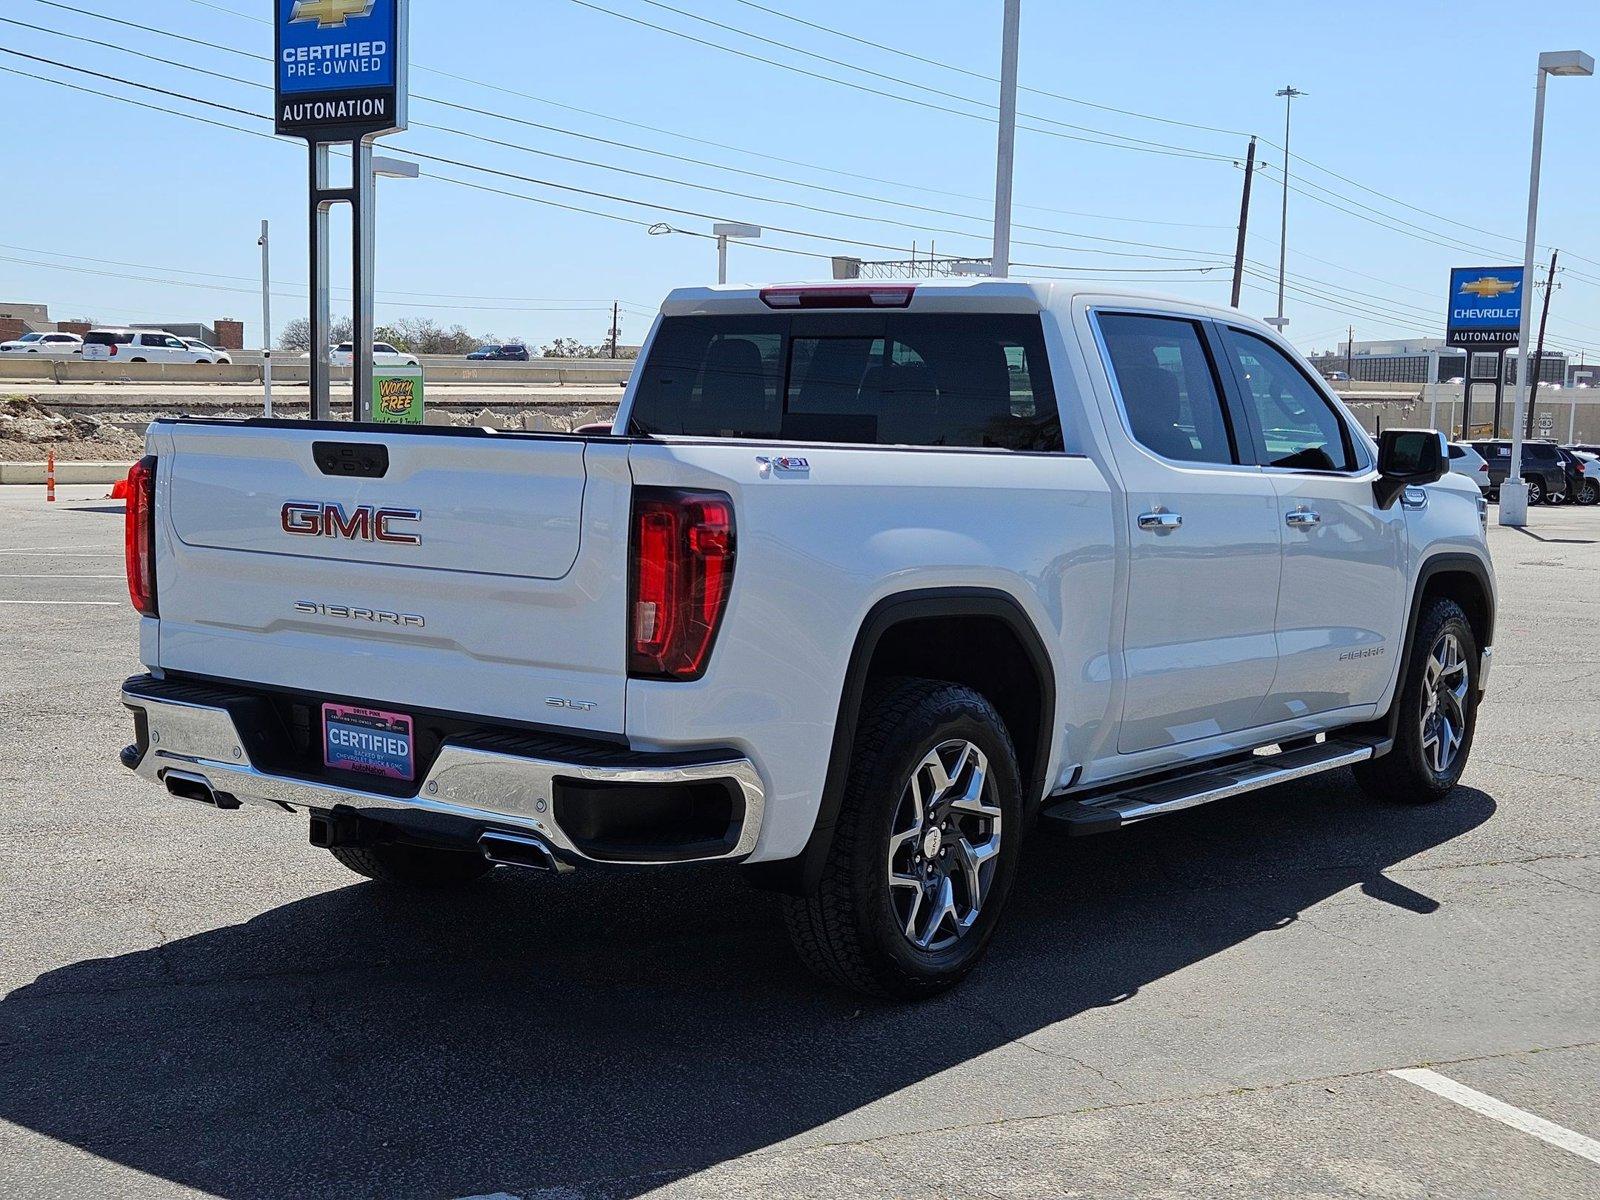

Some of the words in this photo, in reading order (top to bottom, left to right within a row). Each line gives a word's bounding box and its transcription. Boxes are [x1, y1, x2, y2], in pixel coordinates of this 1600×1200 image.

[283, 41, 386, 62] CERTIFIED
[288, 58, 381, 77] PRE-OWNED
[283, 98, 385, 121] AUTONATION
[1454, 308, 1520, 318] CHEVROLET
[1453, 332, 1519, 341] AUTONATION
[381, 395, 413, 412] FREE
[281, 500, 422, 546] GMC
[294, 600, 425, 628] SIERRA
[1339, 647, 1384, 661] SIERRA
[545, 696, 598, 711] SLT
[329, 728, 408, 757] CERTIFIED
[354, 750, 375, 759] BACKED
[351, 763, 386, 776] AutoNation
